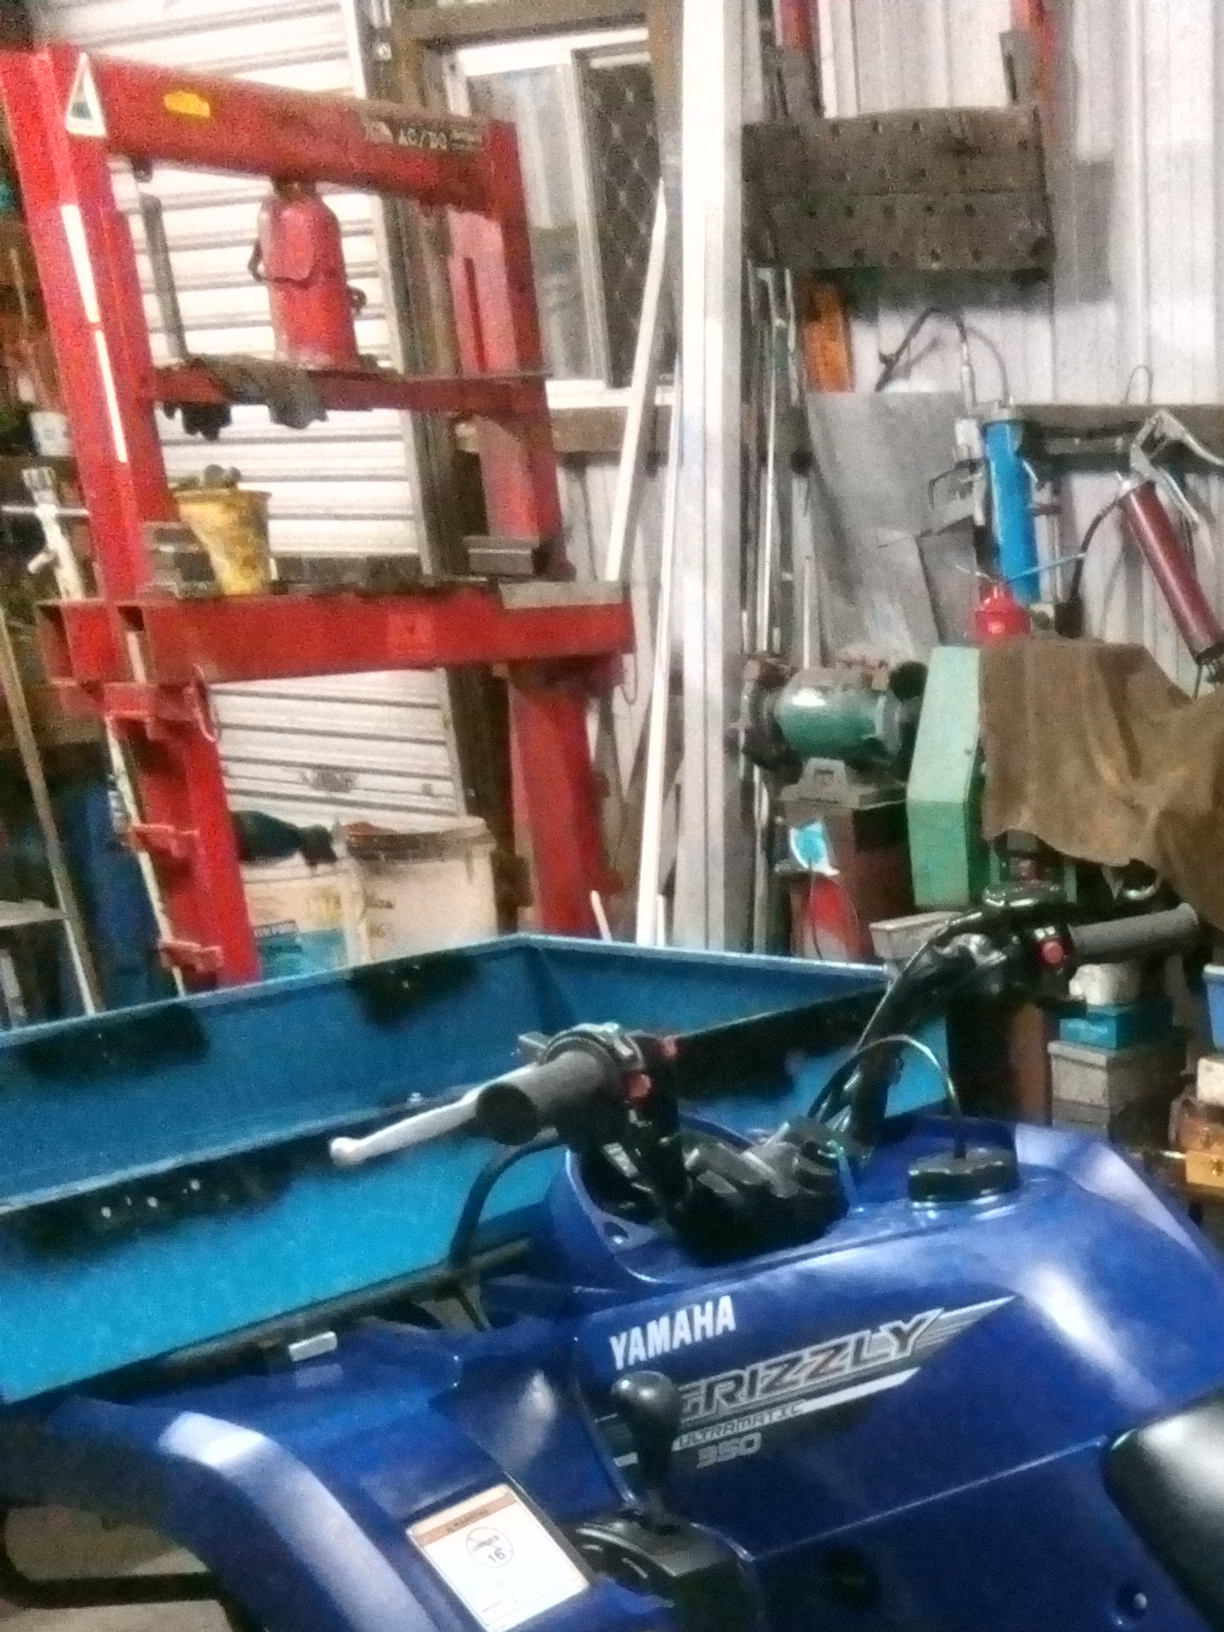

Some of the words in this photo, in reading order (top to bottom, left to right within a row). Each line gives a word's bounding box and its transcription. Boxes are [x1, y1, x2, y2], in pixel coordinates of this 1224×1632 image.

[610, 1295, 736, 1370] YAMAHA
[697, 1432, 762, 1468] 350
[487, 1547, 507, 1564] 16
